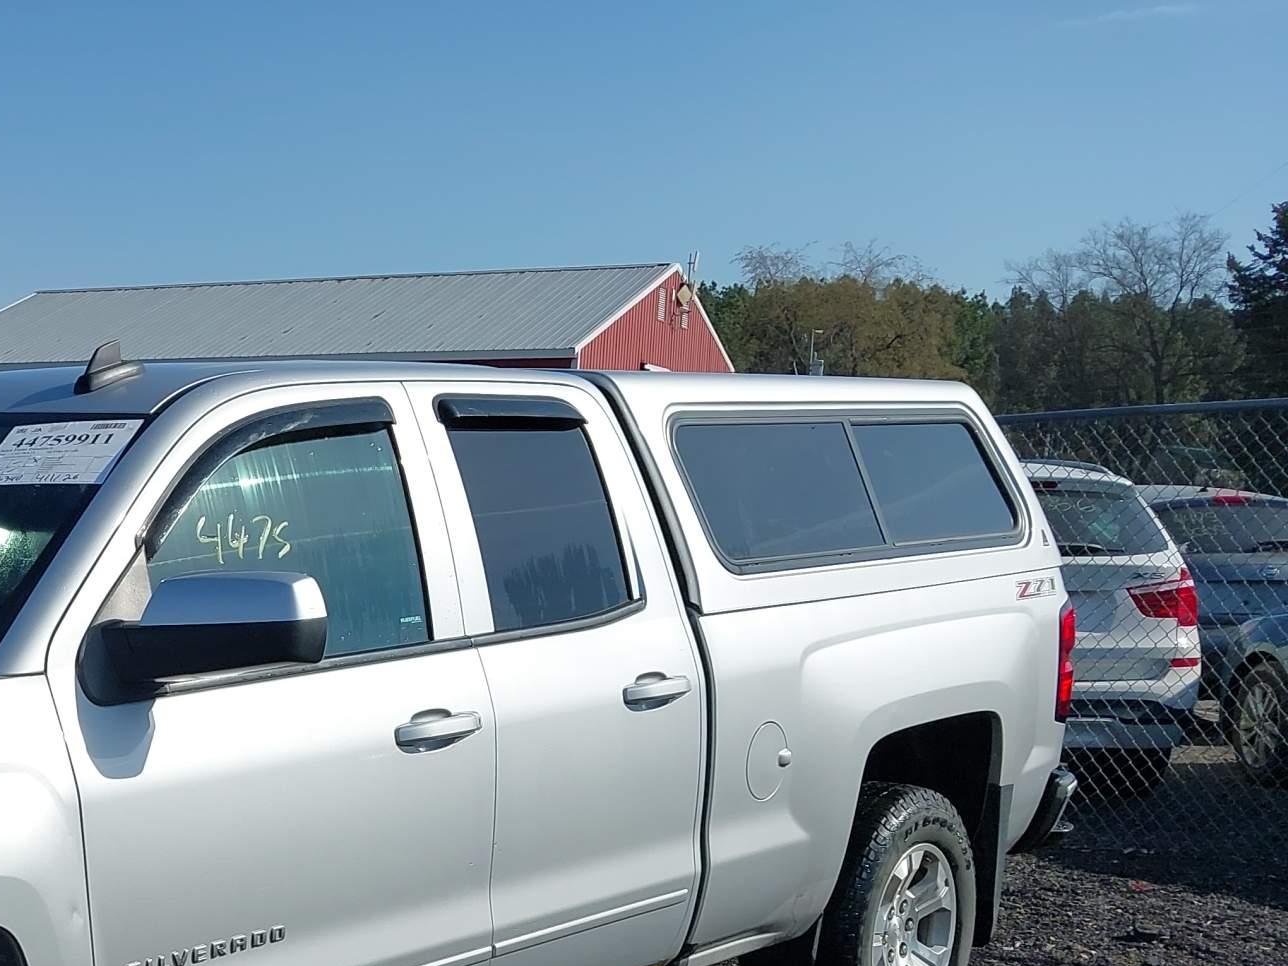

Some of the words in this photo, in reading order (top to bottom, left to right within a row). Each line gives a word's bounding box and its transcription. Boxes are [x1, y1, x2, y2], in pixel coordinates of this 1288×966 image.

[12, 432, 114, 448] 44759911
[196, 513, 291, 564] 4475
[1016, 577, 1056, 600] Z71
